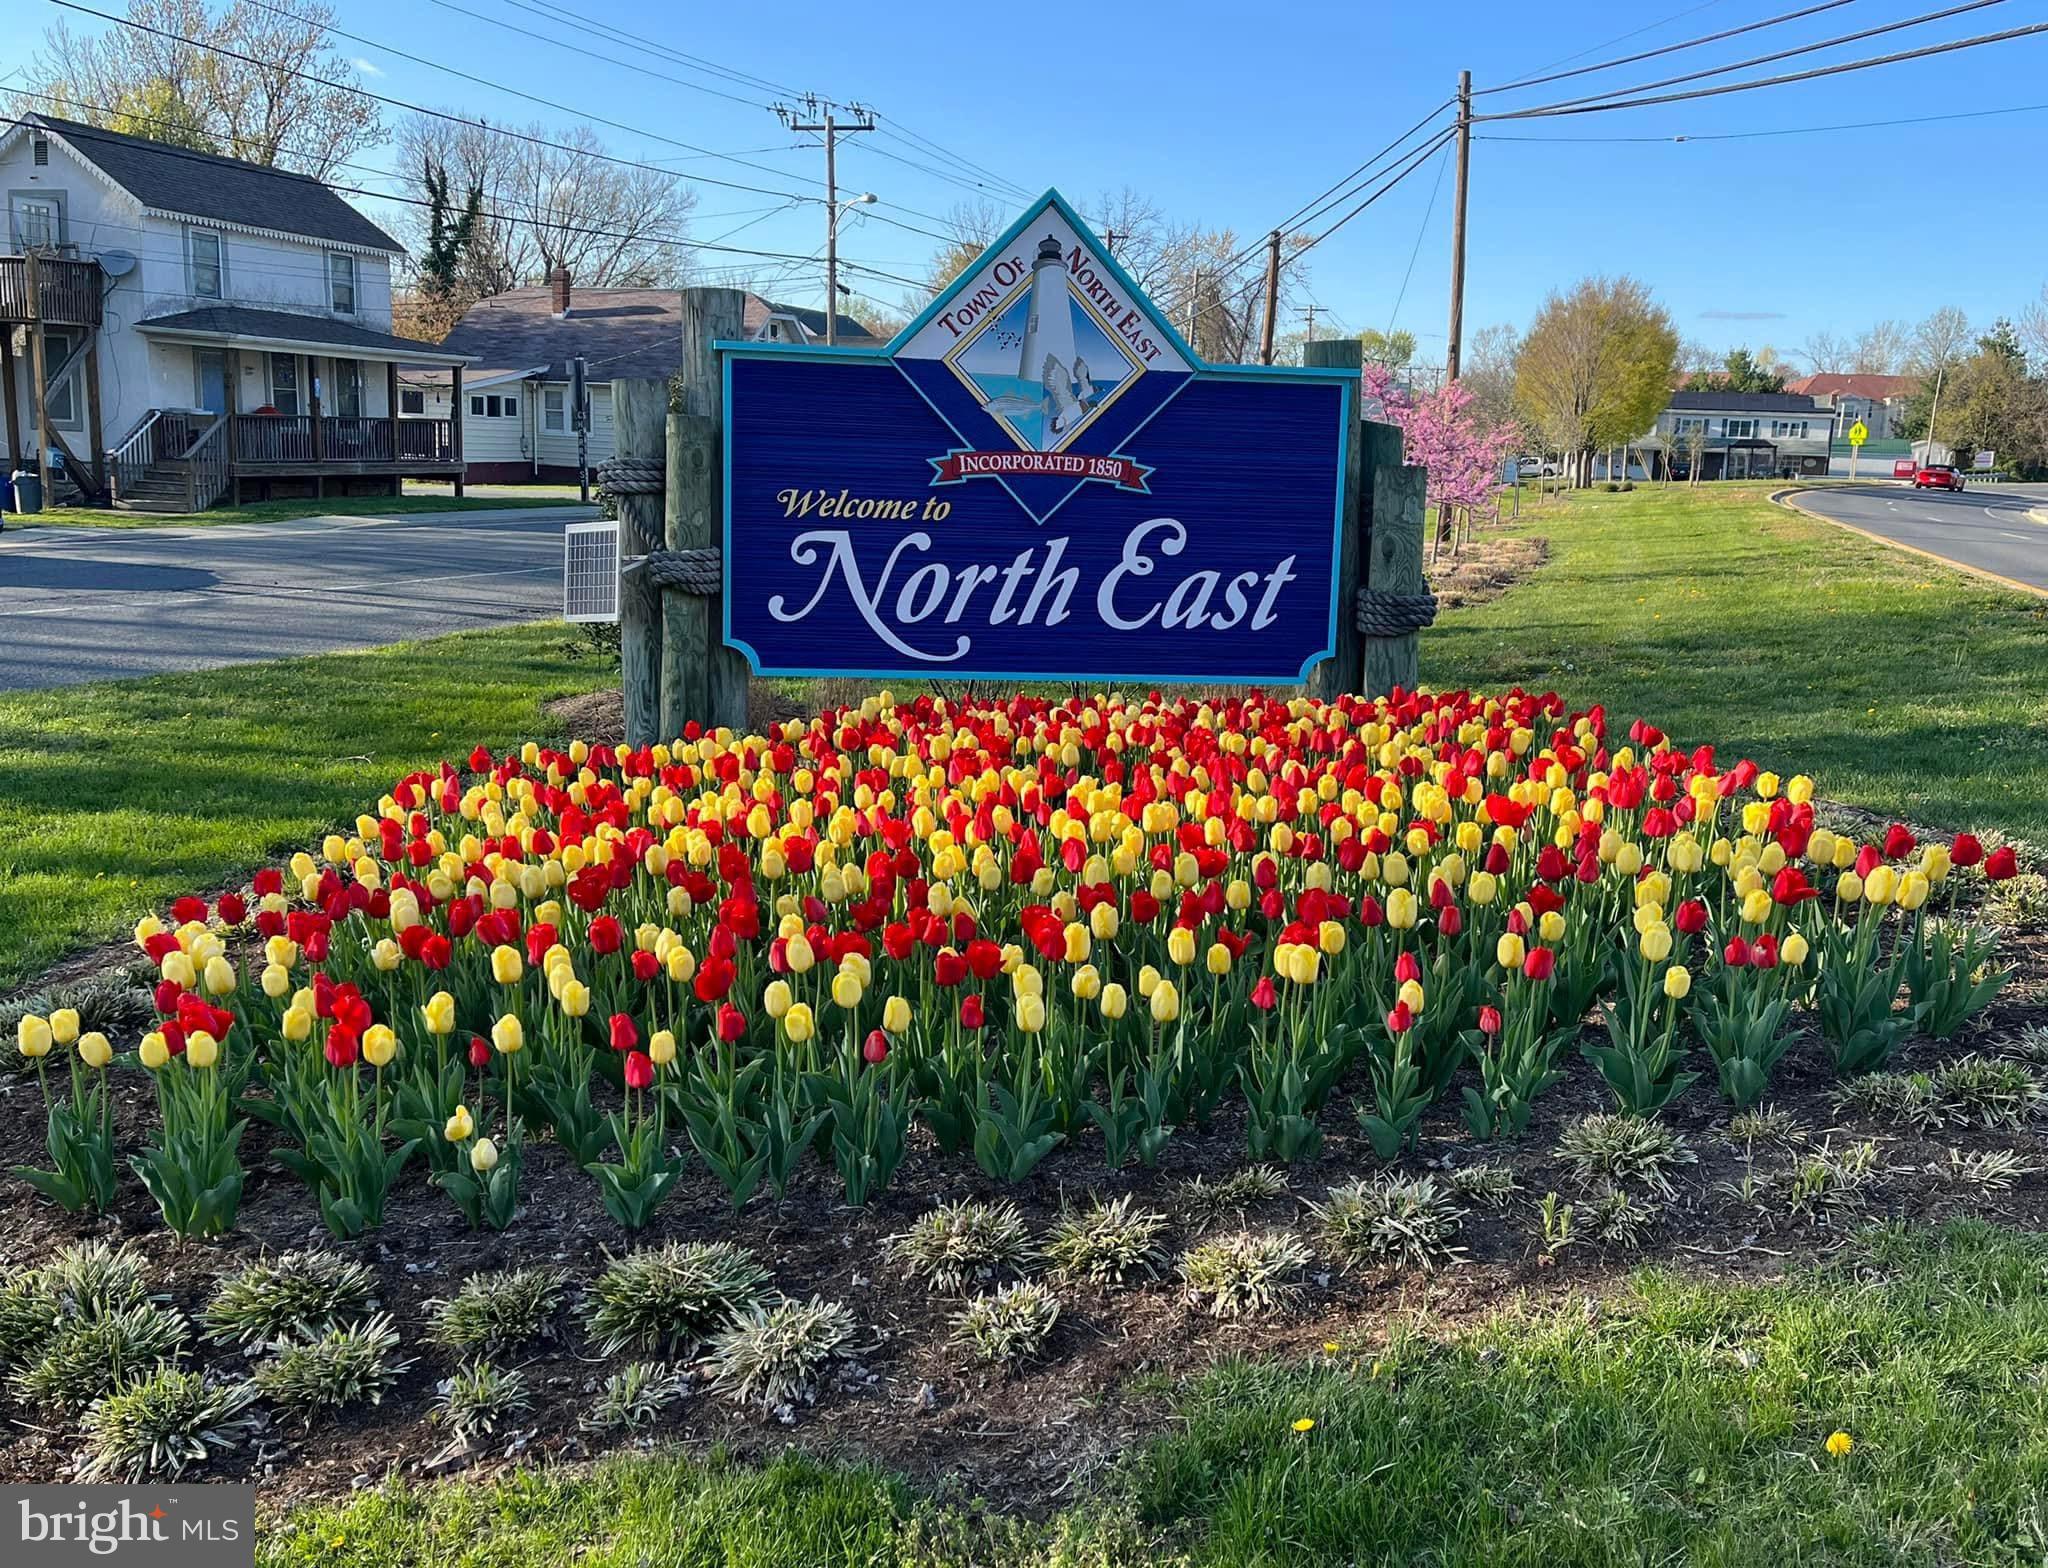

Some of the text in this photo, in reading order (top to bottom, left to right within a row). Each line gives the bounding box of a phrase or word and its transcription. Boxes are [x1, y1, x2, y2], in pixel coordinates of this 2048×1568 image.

[937, 282, 999, 338] TOWN
[1066, 245, 1162, 362] NORTH EAST
[959, 454, 1122, 478] INCORPORATED 1850
[776, 489, 951, 521] Welcome to
[768, 518, 1297, 662] North East
